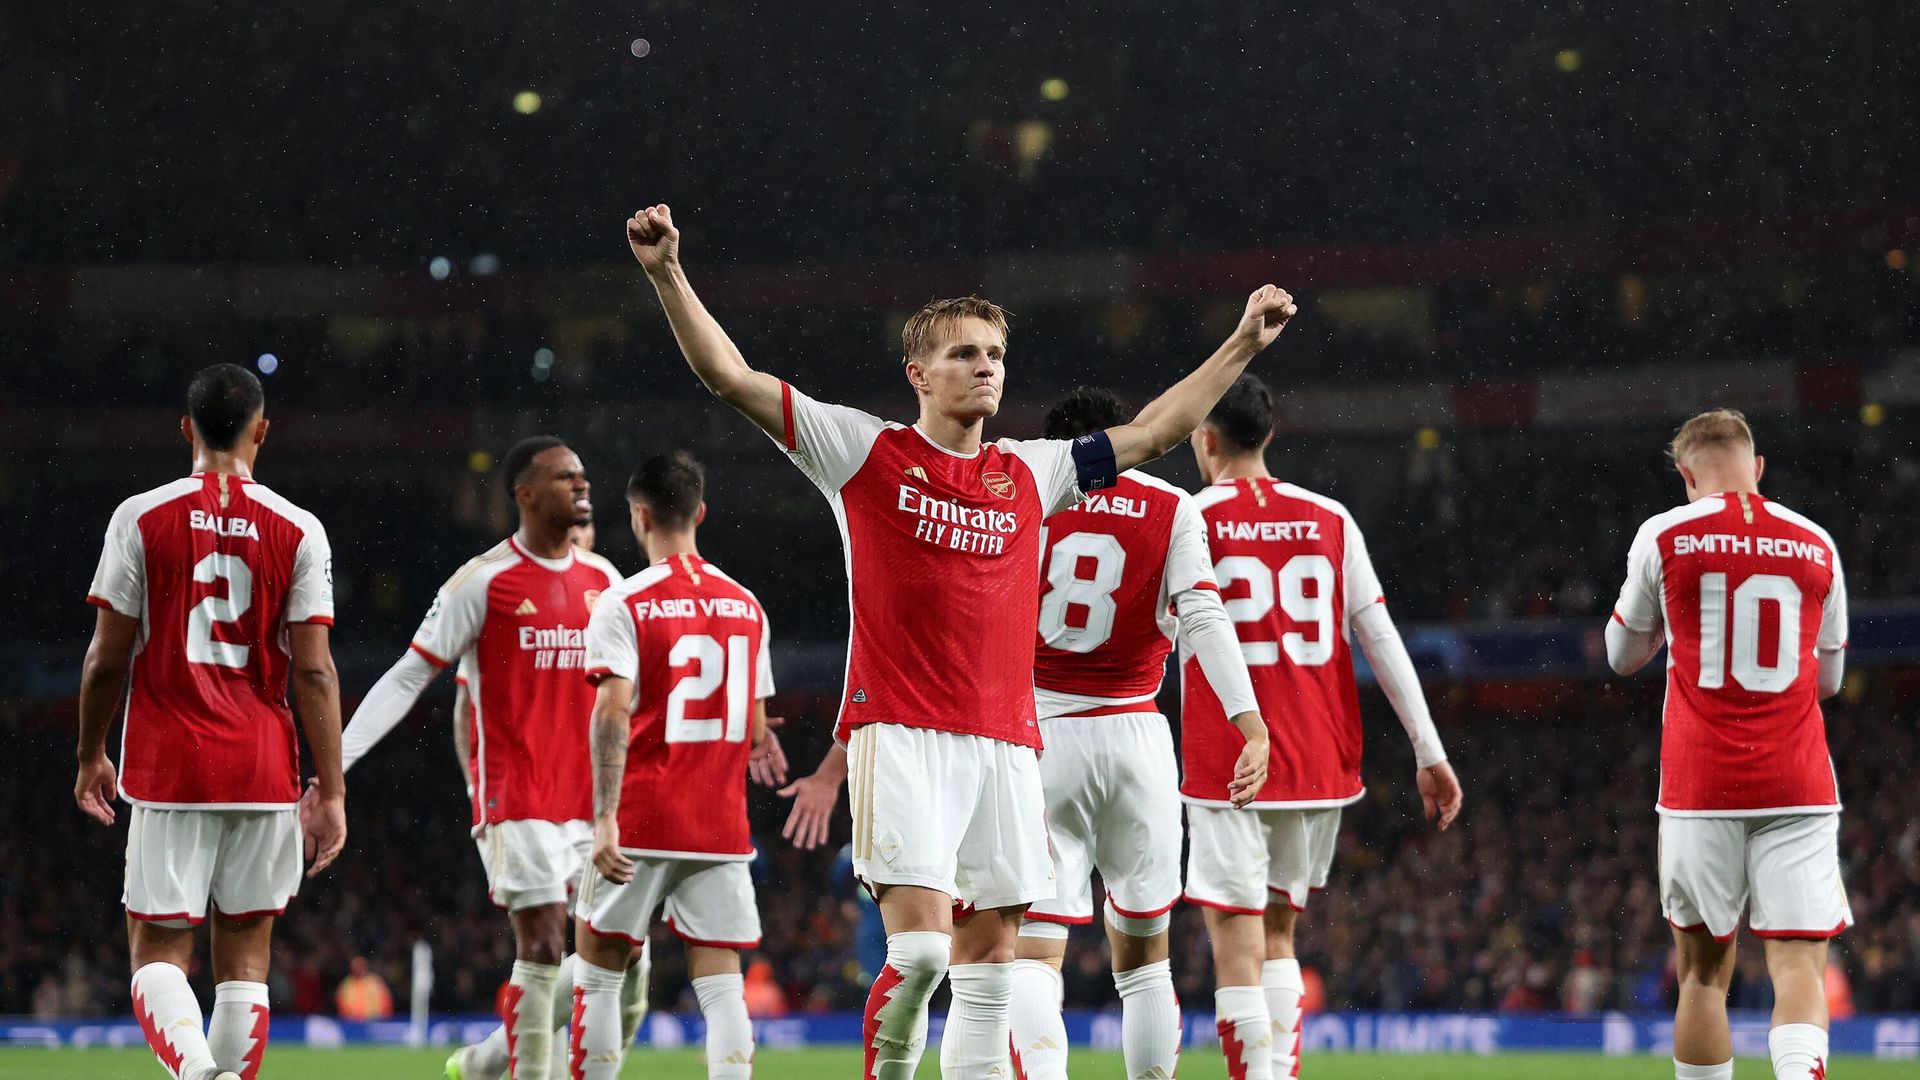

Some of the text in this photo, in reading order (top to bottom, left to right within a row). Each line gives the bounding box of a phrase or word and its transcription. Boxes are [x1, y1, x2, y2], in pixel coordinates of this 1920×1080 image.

[898, 484, 1017, 533] Emirates
[1067, 492, 1147, 518] YASU
[915, 519, 1004, 555] FLY BETTER
[1216, 520, 1321, 541] HAVERTZ
[1673, 534, 1826, 566] SMITH ROWE
[187, 552, 253, 668] 2
[634, 598, 697, 621] FÁBIO
[1213, 555, 1336, 666] 29
[1698, 573, 1801, 692] 10
[534, 649, 555, 670] FLY
[665, 635, 749, 743] 21
